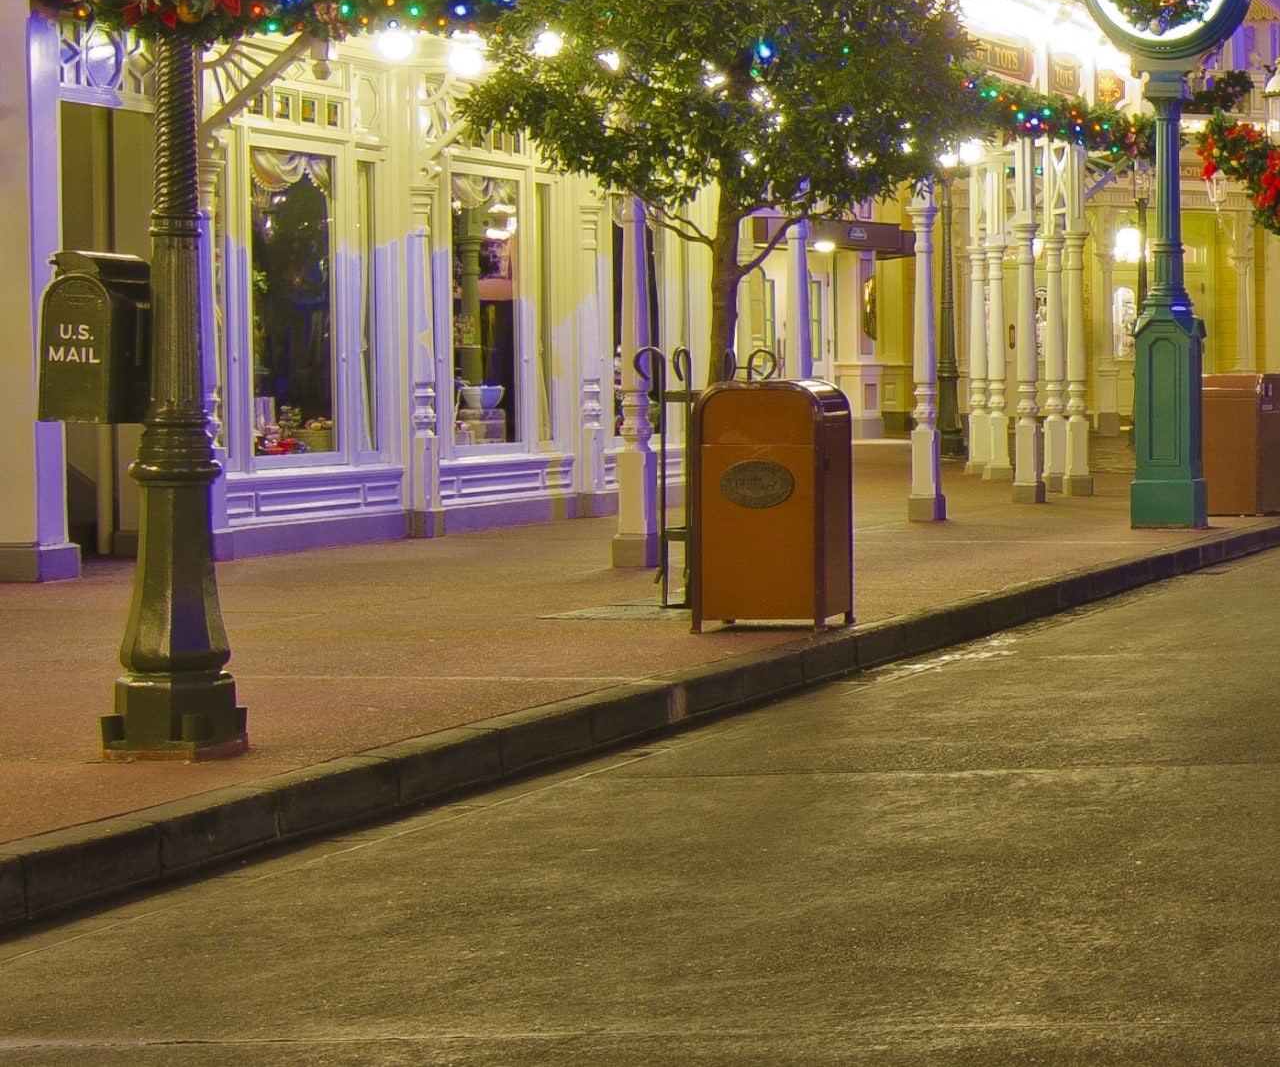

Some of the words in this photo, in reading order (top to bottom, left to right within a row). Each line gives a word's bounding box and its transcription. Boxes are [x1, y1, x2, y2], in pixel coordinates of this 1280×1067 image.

[994, 46, 1019, 70] TOYS
[1054, 65, 1074, 87] TOYS
[60, 323, 94, 340] U.S.
[48, 346, 100, 363] MAIL
